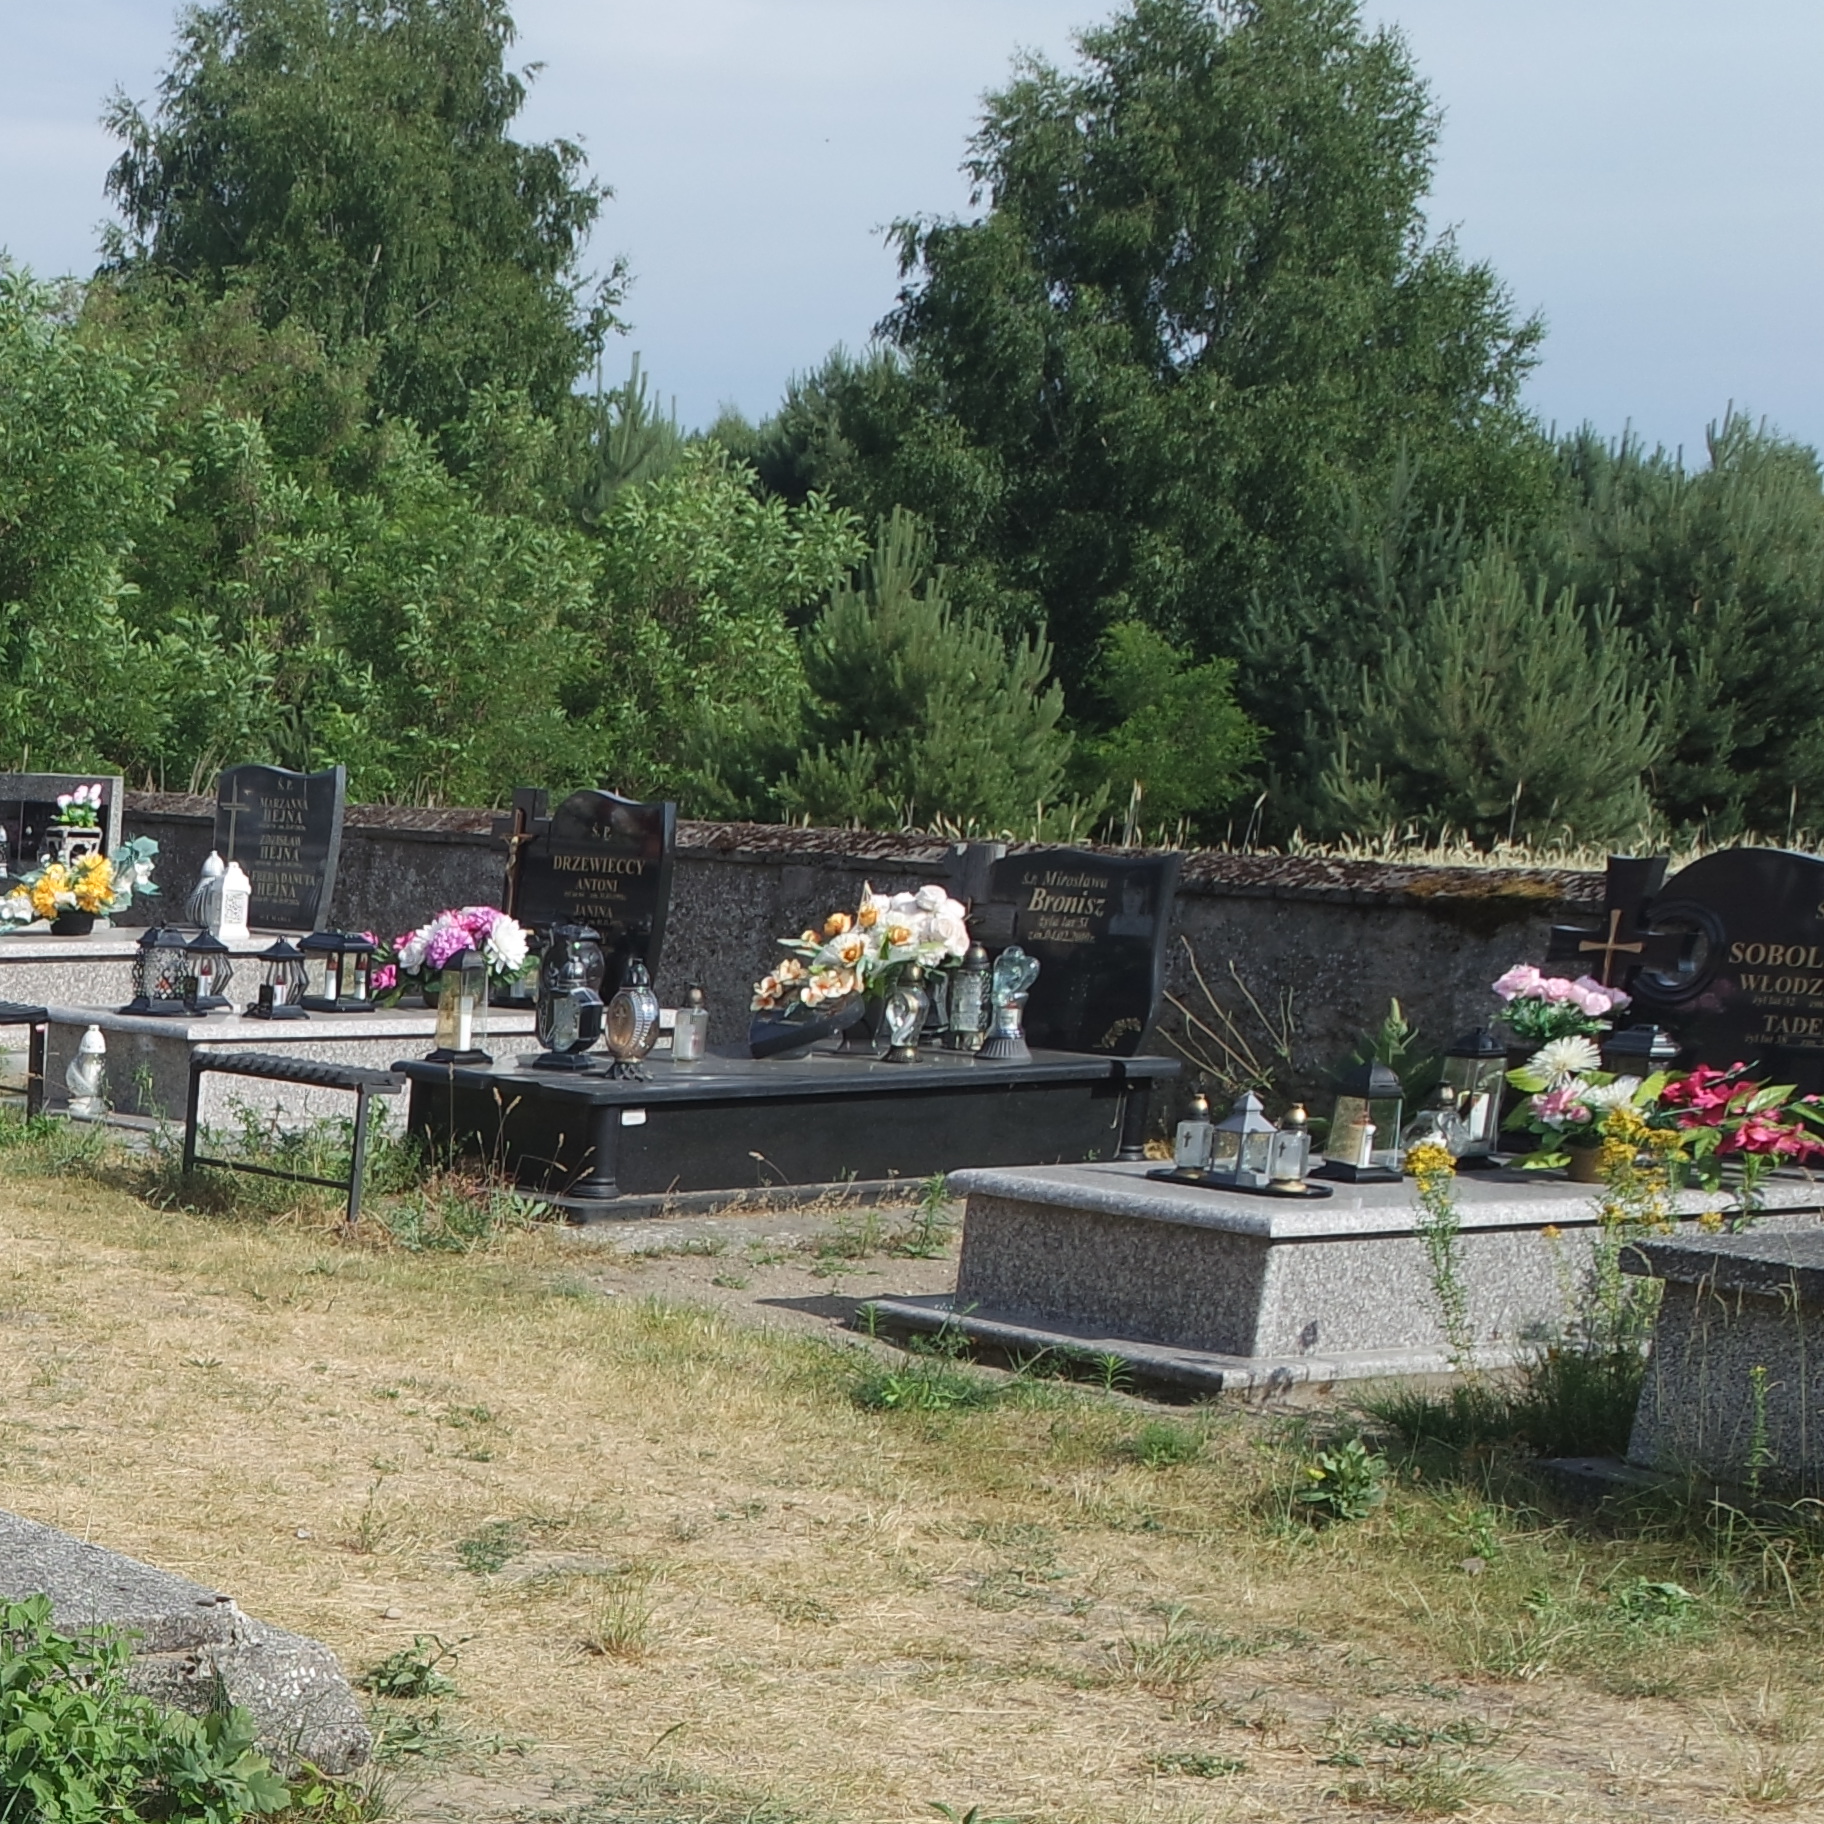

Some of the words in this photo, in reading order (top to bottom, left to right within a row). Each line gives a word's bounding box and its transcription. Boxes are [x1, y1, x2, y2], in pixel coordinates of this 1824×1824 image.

[553, 855, 646, 876] DRZEWIECCY
[576, 878, 619, 892] ANTONI
[1027, 886, 1107, 918] Bronisz
